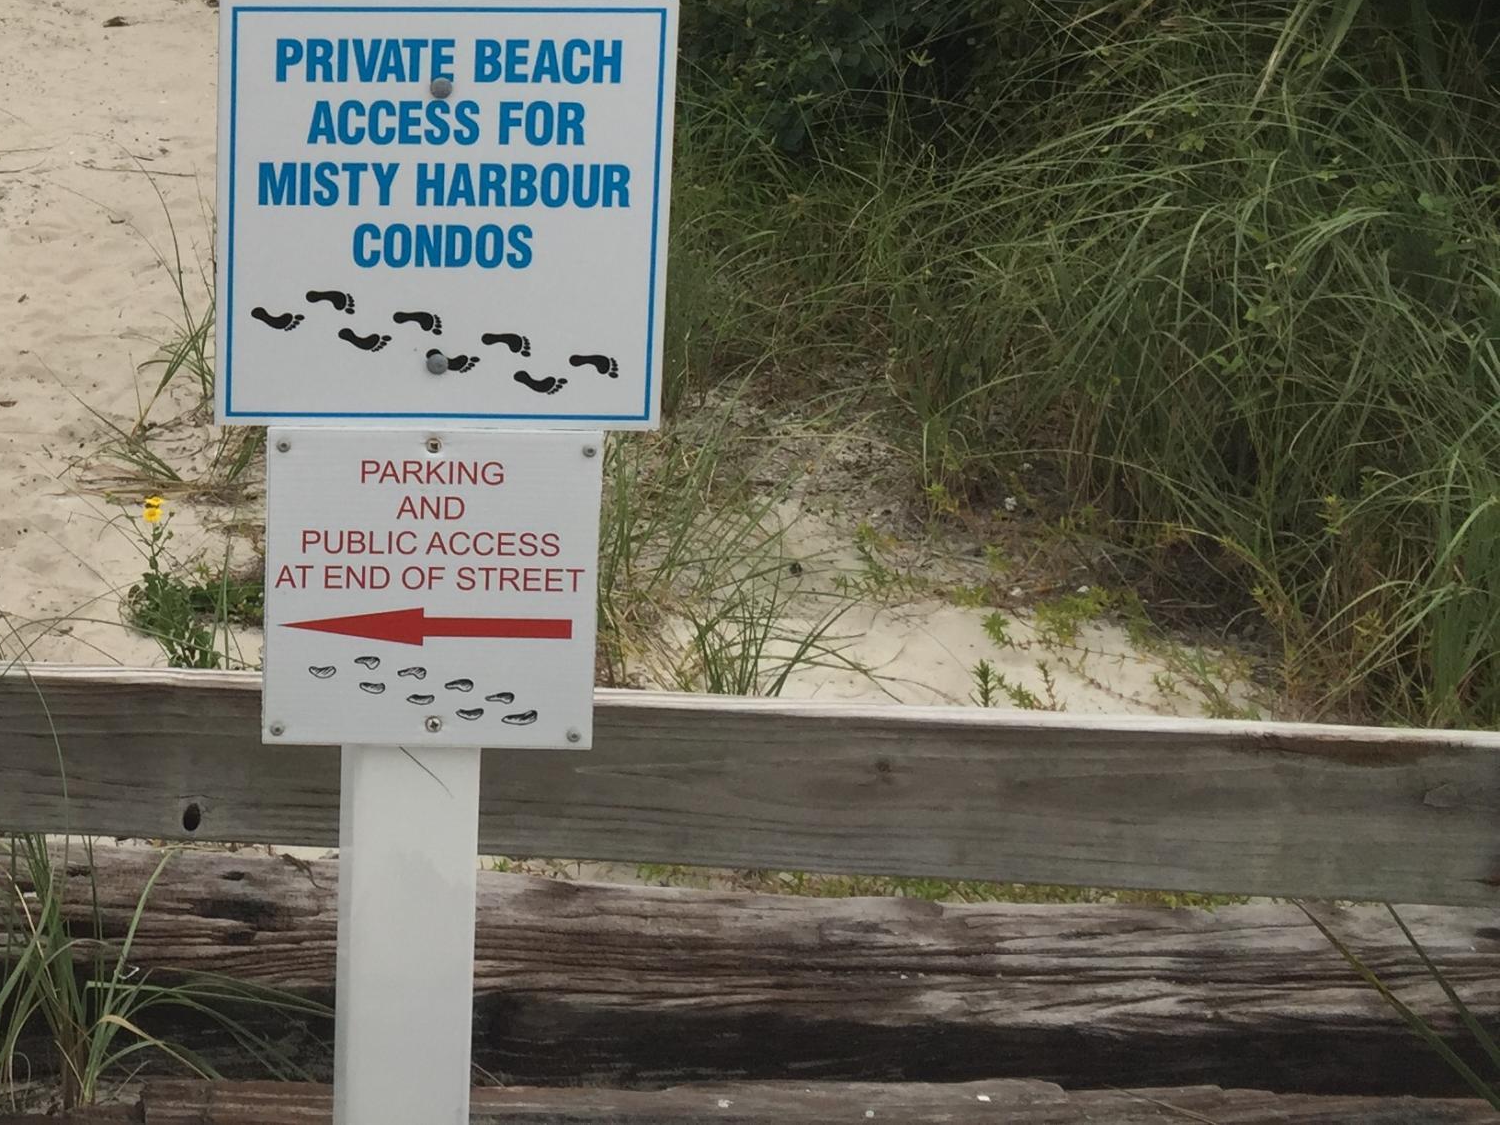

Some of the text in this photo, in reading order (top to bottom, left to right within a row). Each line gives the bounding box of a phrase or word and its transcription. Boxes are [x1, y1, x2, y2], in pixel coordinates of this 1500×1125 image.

[276, 38, 623, 85] PRIVATE BEACH
[308, 99, 586, 147] ACCESS FOR
[258, 161, 631, 209] MISTY HARBOUR
[352, 223, 533, 270] CONDOS
[361, 459, 503, 485] PARKING
[397, 496, 466, 520] AND
[302, 530, 560, 557] PUBLIC ACCESS
[275, 565, 585, 592] AT END OF STREET
